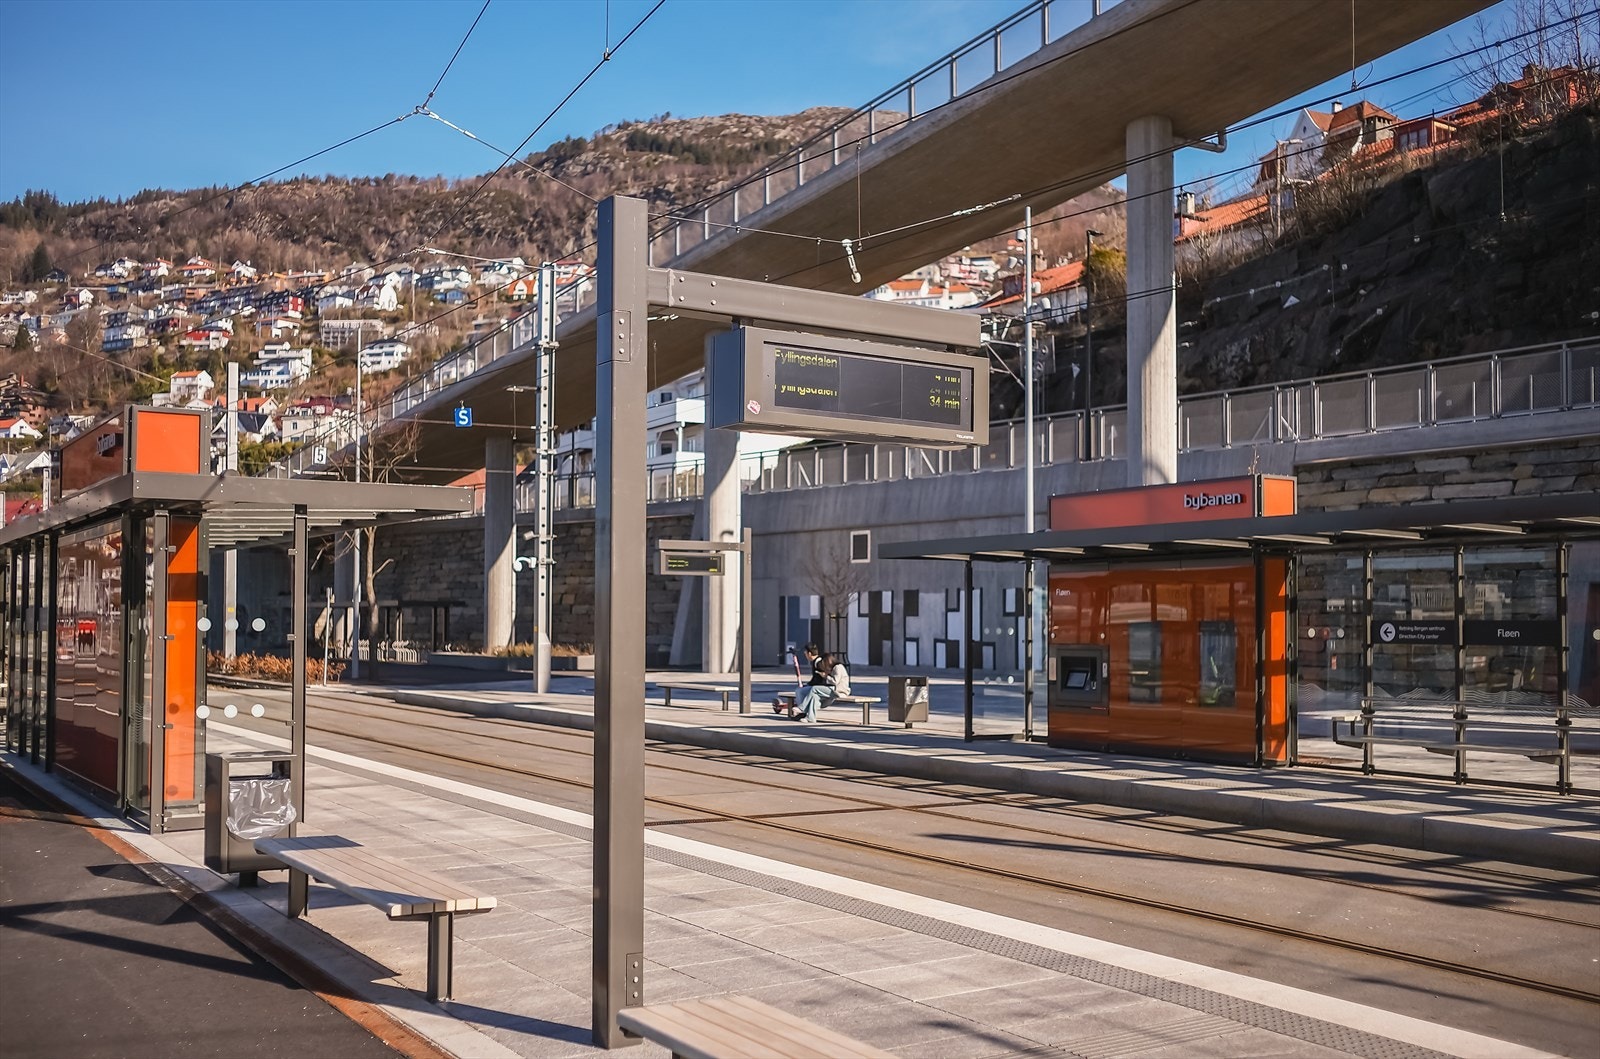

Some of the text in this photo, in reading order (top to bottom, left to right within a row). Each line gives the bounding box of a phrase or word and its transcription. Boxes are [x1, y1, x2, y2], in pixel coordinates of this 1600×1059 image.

[775, 349, 838, 368] Fyllingsdalen
[929, 395, 960, 409] 34 min
[458, 409, 469, 425] S
[317, 449, 324, 462] 5
[1183, 492, 1241, 510] bybanen
[1497, 628, 1520, 638] Fløen
